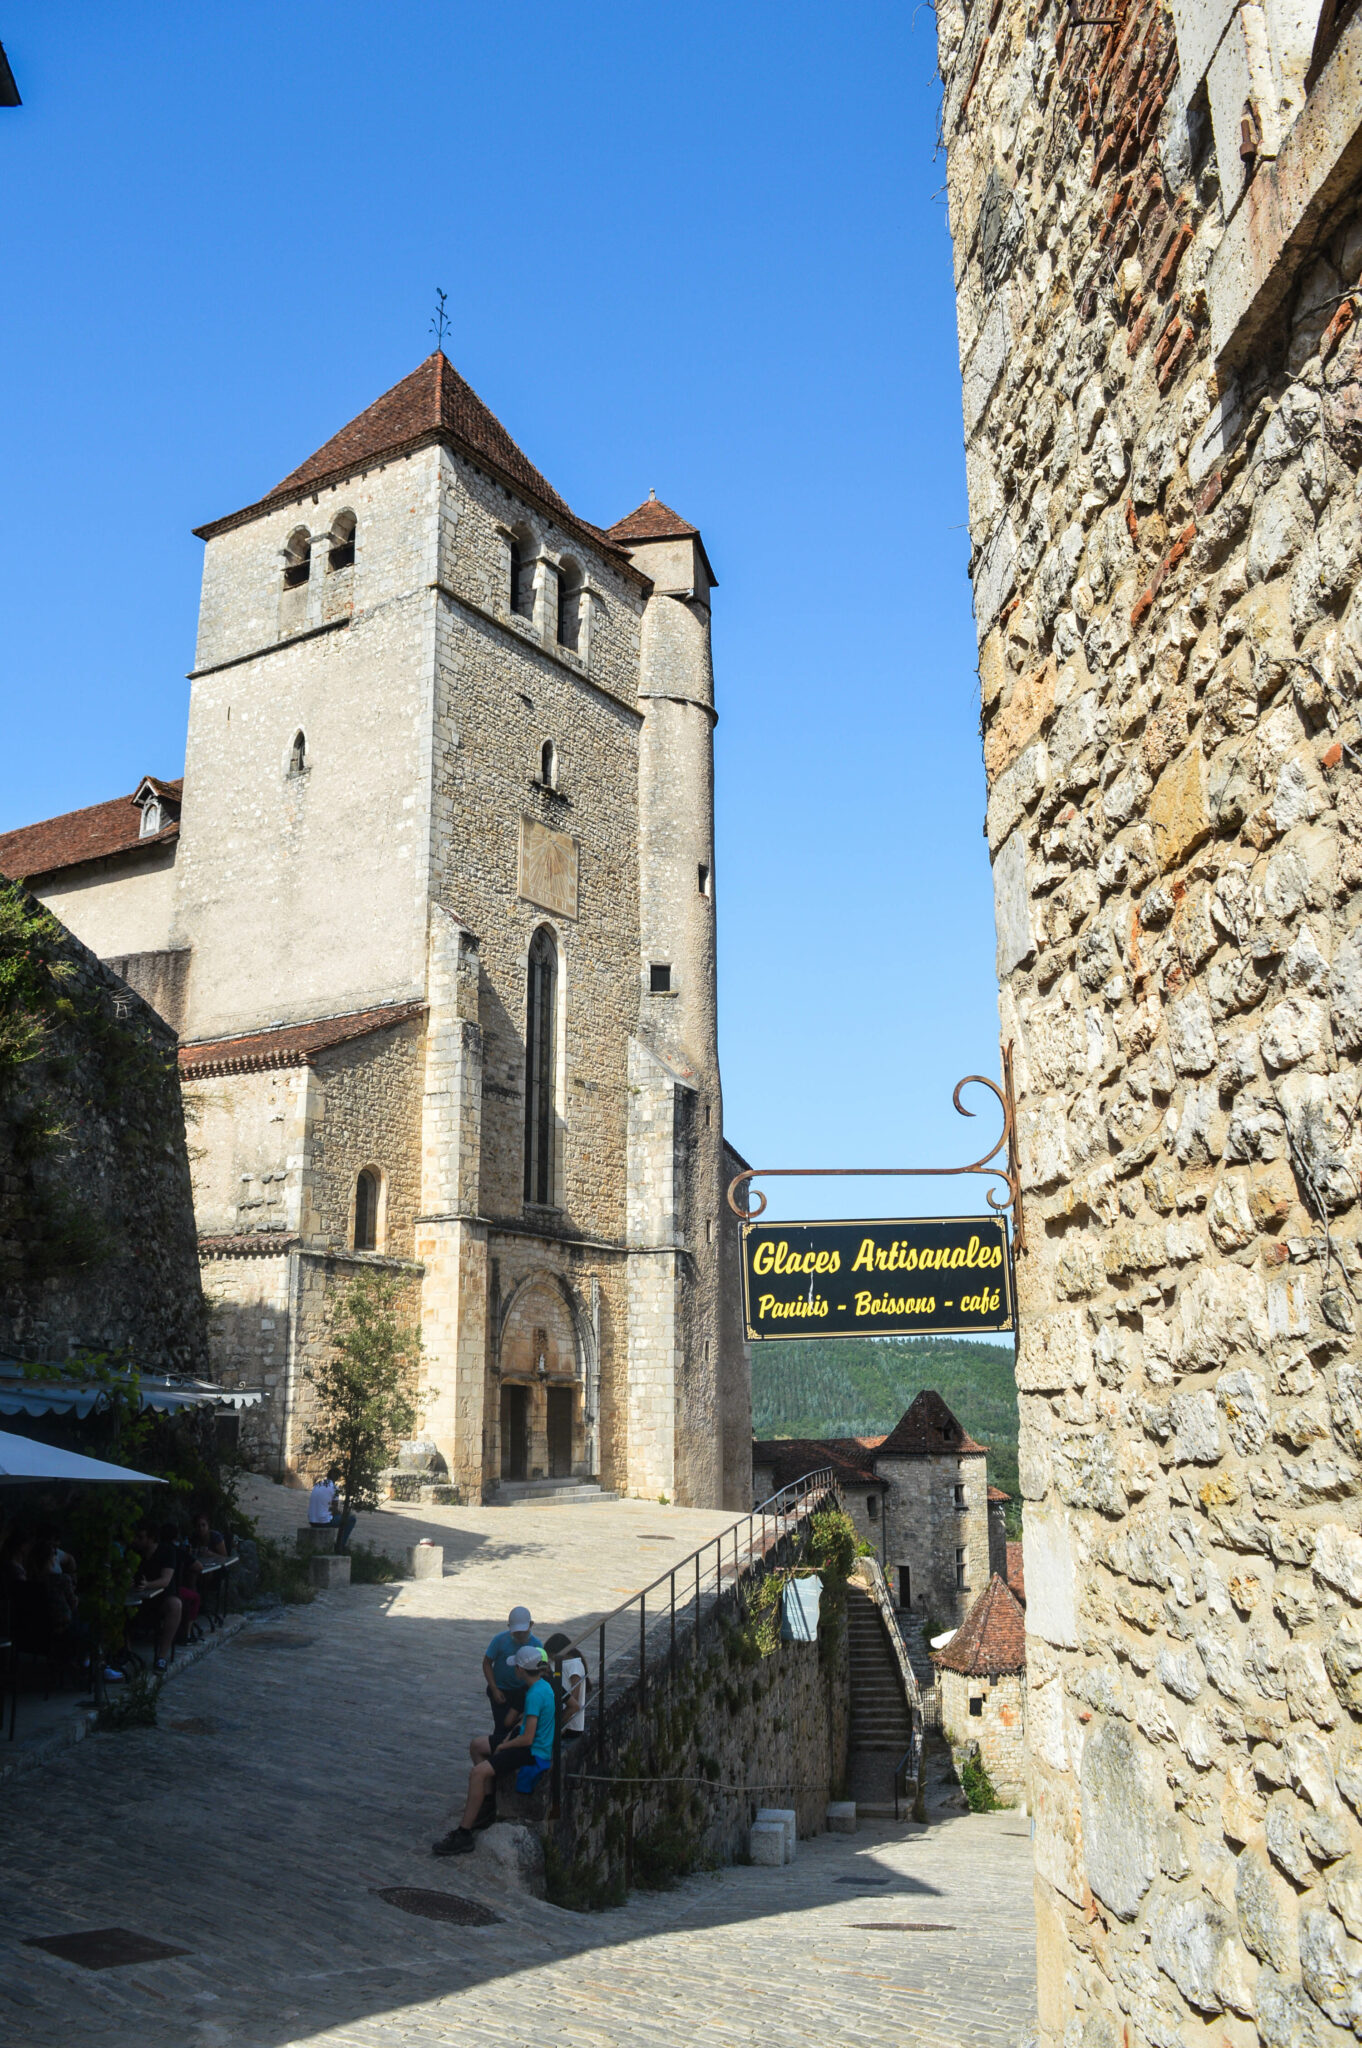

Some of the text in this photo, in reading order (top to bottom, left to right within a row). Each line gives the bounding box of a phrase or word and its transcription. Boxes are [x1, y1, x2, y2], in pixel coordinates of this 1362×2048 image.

[753, 1236, 1002, 1275] Glaces Artisanales
[759, 1294, 829, 1319] Paninis
[854, 1291, 936, 1316] Boissons
[960, 1287, 1001, 1315] café
